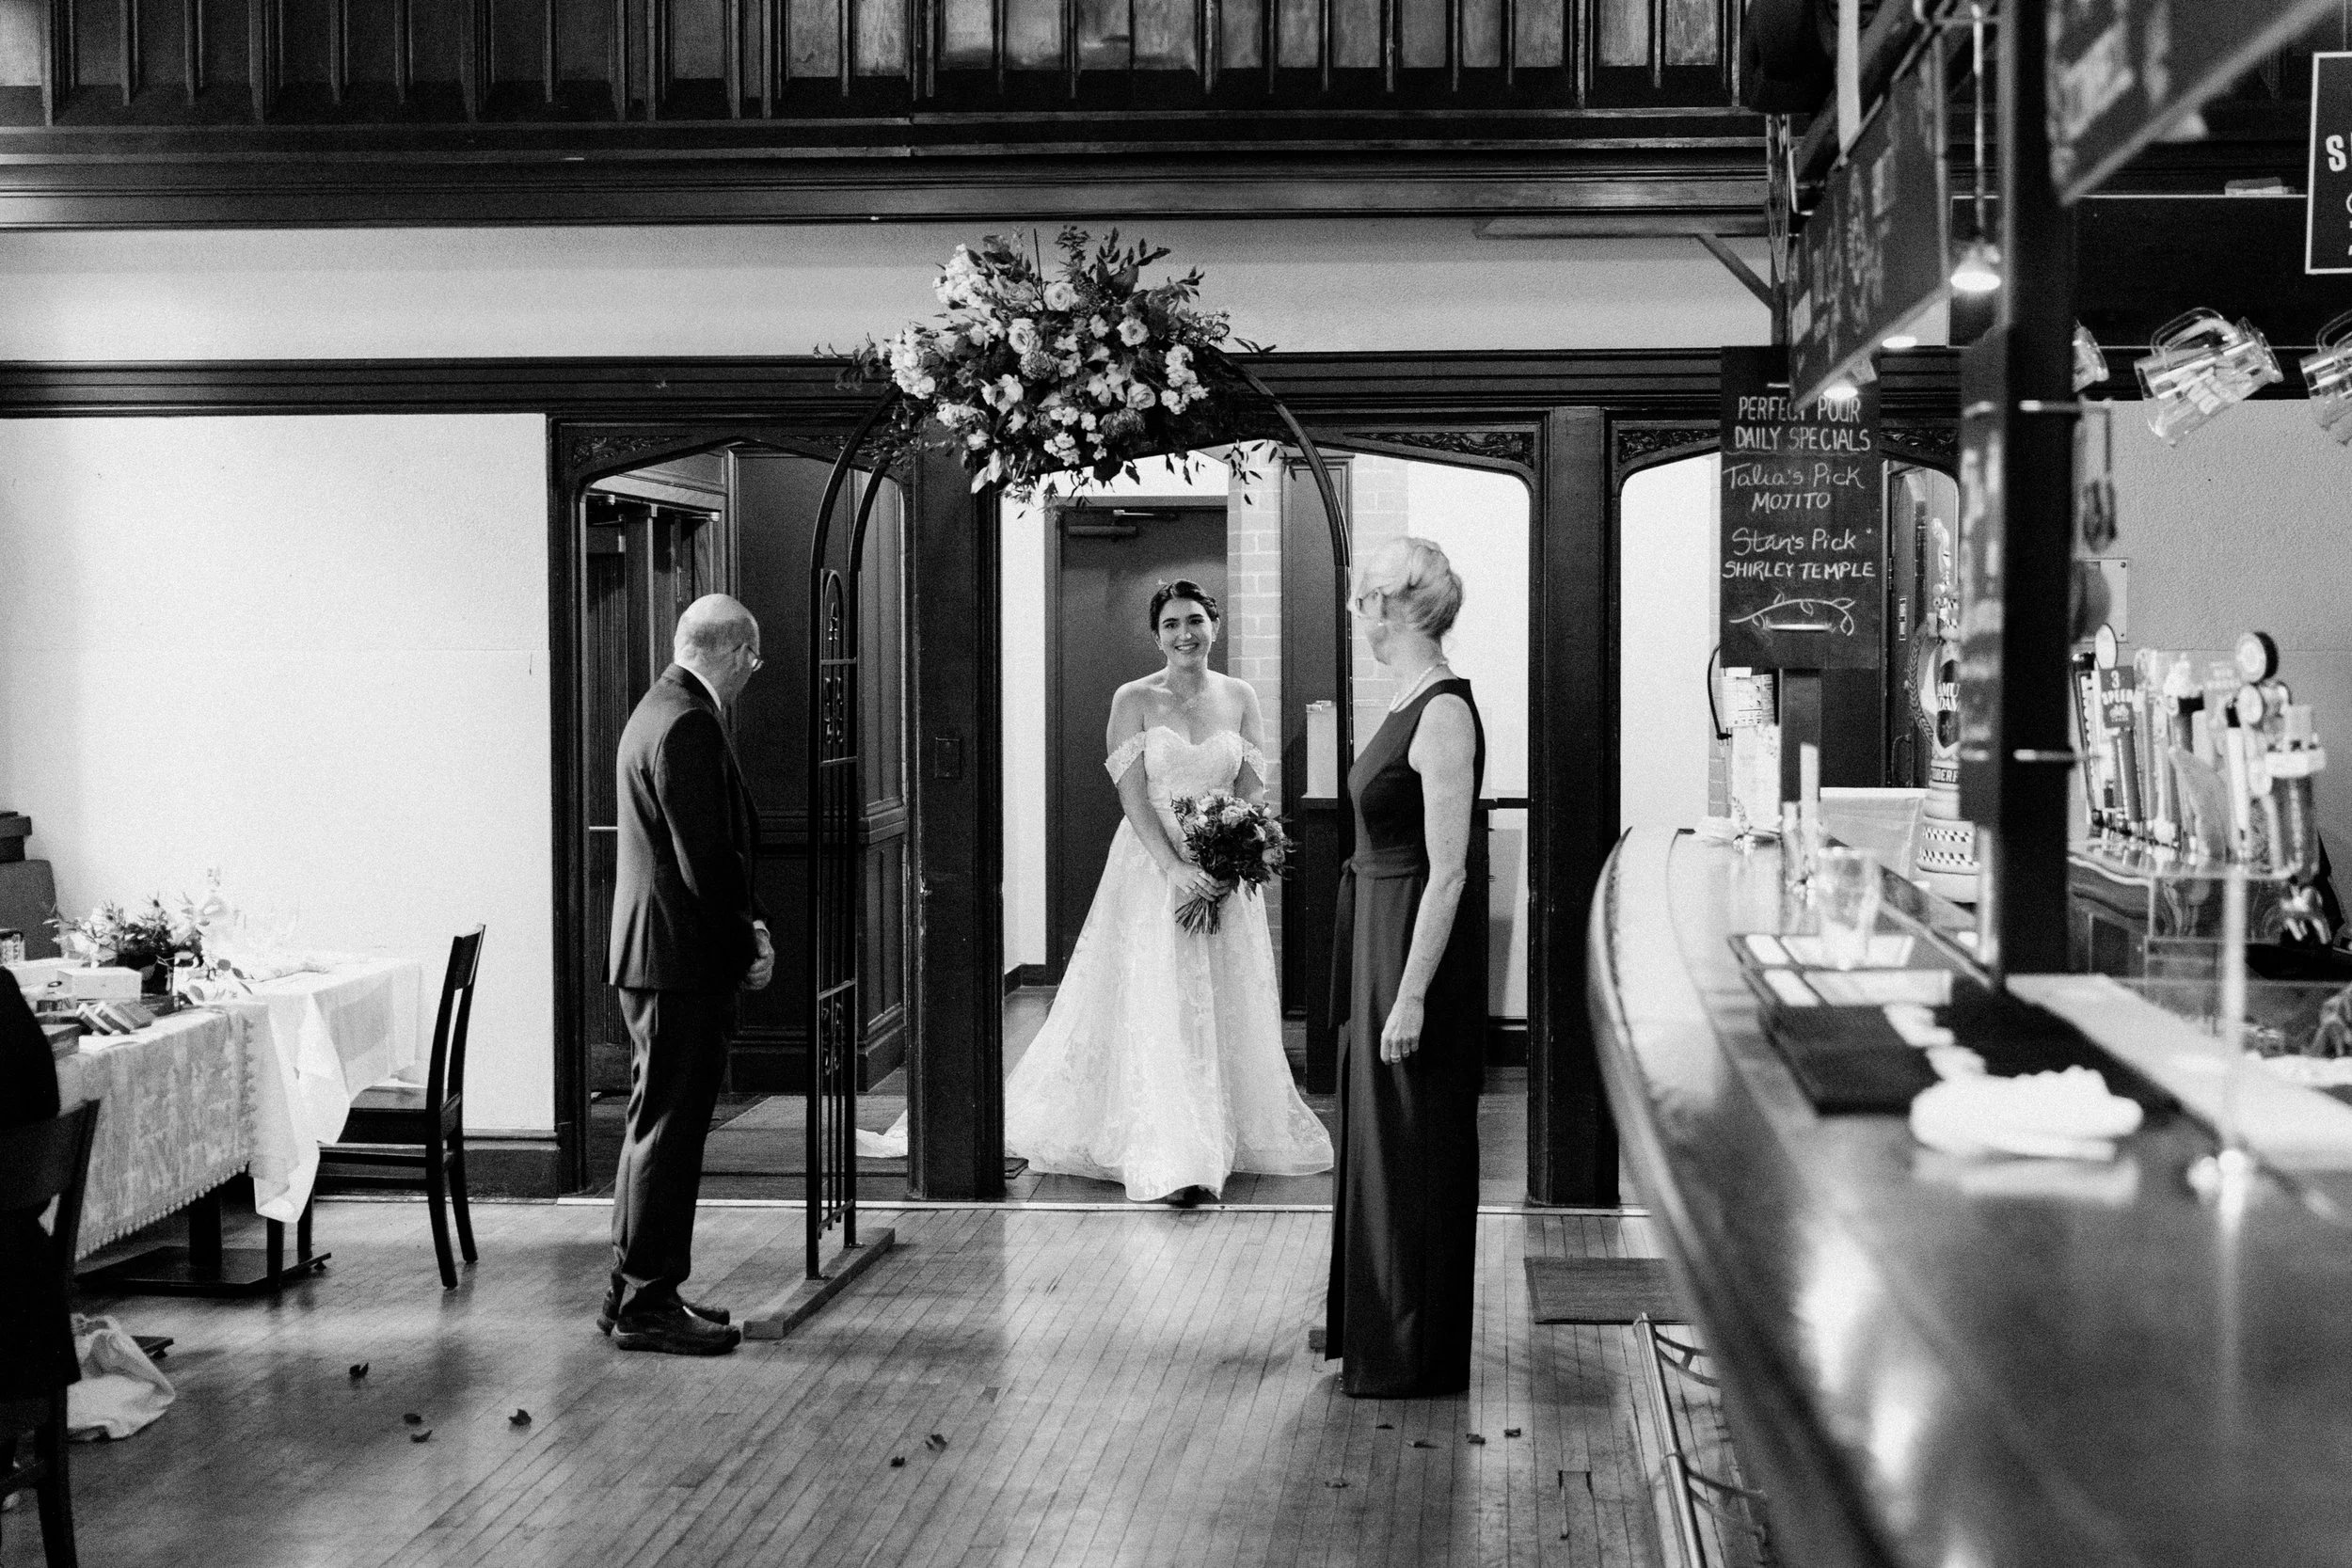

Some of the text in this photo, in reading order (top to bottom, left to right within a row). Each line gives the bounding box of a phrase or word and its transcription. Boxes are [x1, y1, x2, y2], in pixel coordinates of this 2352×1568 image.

[1817, 395, 1861, 423] POUR
[1735, 425, 1871, 451] DAILY SPECIALS
[1722, 462, 1866, 489] Talia's Pick
[1751, 492, 1832, 514] MOJITO
[1731, 527, 1857, 556] Stan's Pick
[1722, 561, 1876, 581] SHIRLEY TEMPLE
